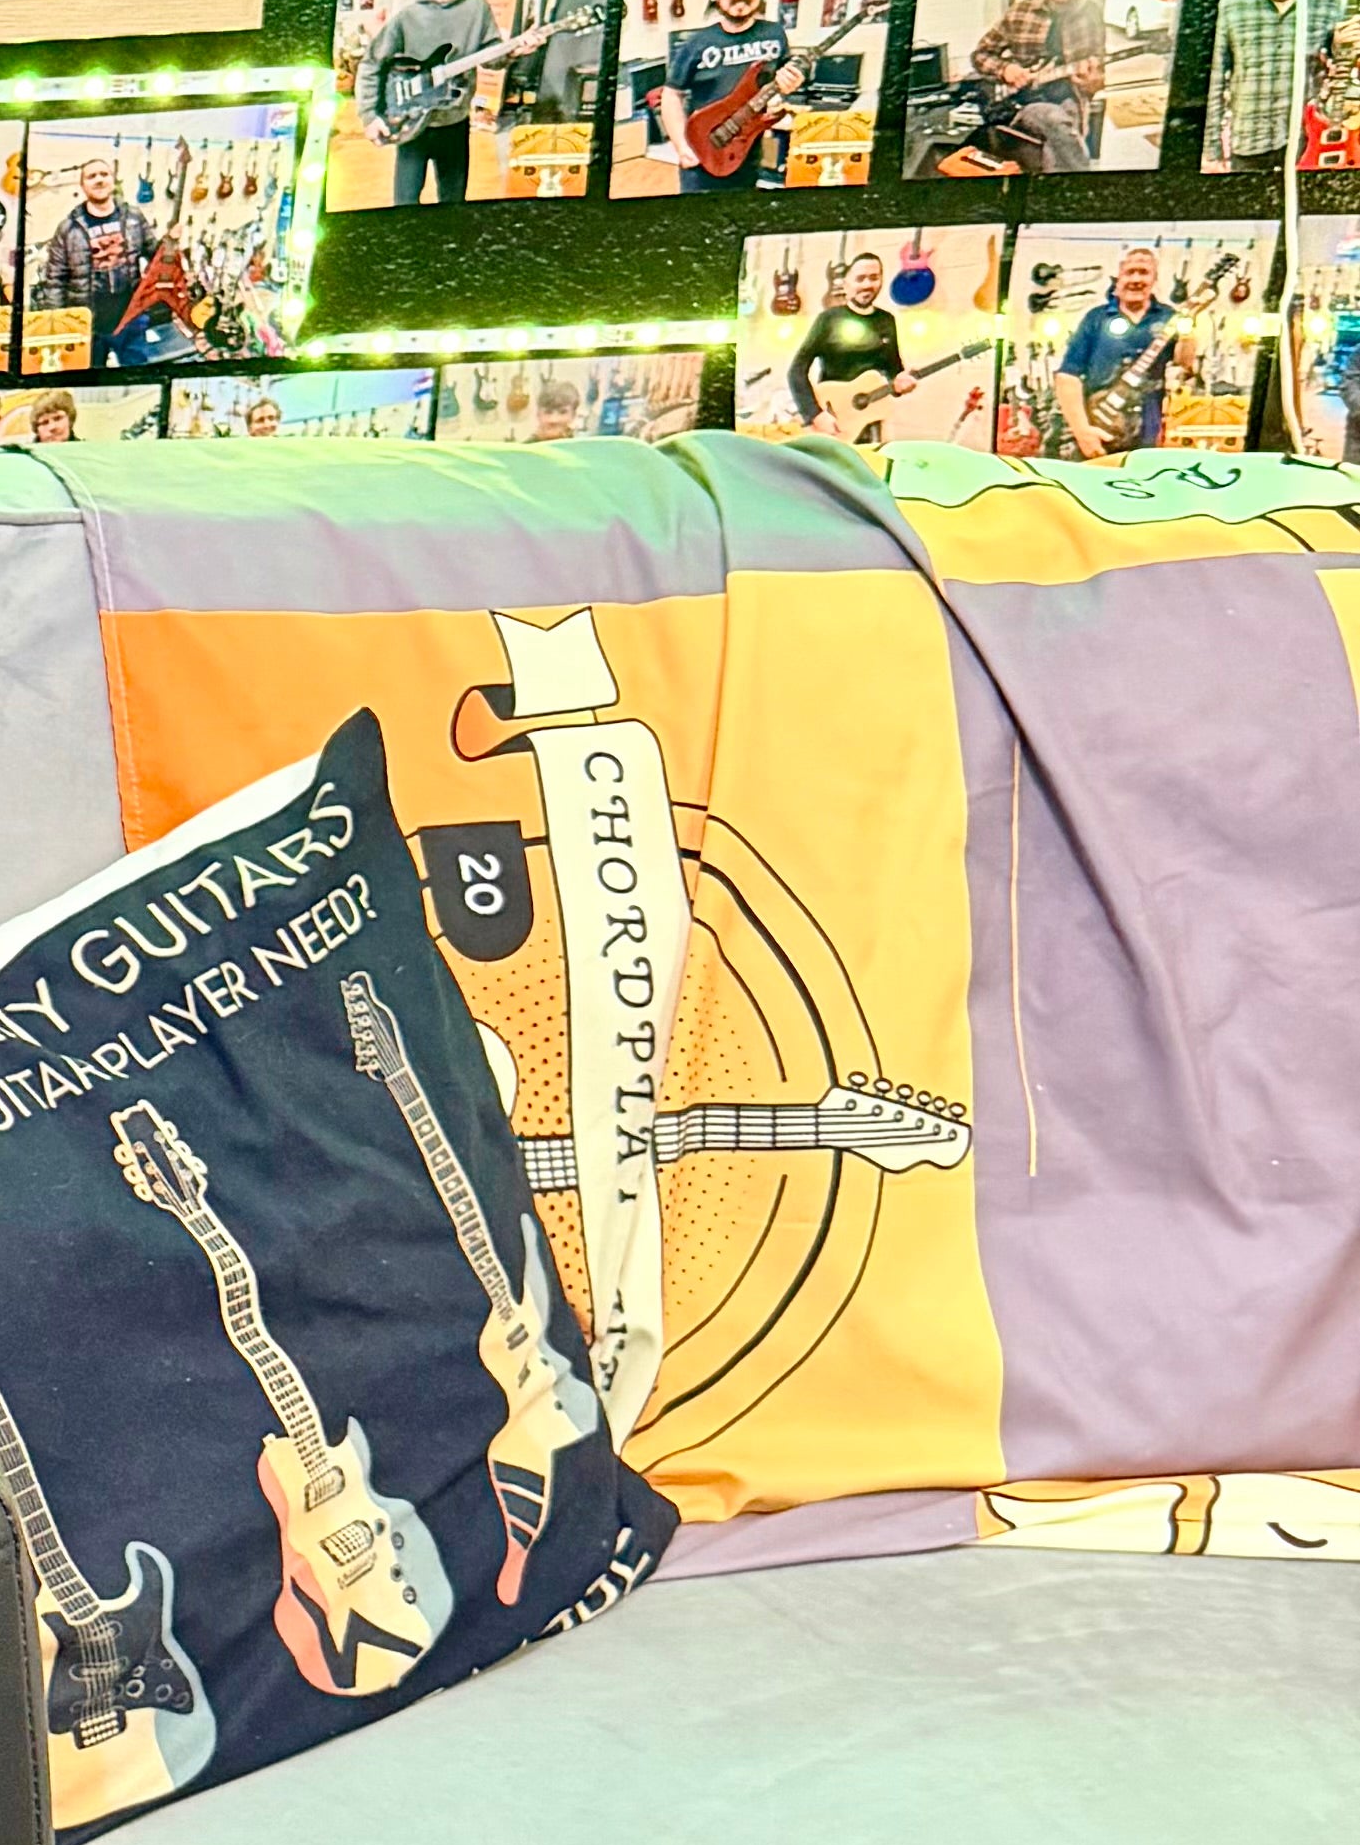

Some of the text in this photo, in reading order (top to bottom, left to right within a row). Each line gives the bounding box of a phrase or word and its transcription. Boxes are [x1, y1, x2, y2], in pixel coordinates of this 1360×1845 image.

[68, 781, 359, 994] GUITARS
[255, 872, 377, 985] NEED?
[456, 850, 500, 915] 20
[583, 751, 656, 1203] CHORDPLA
